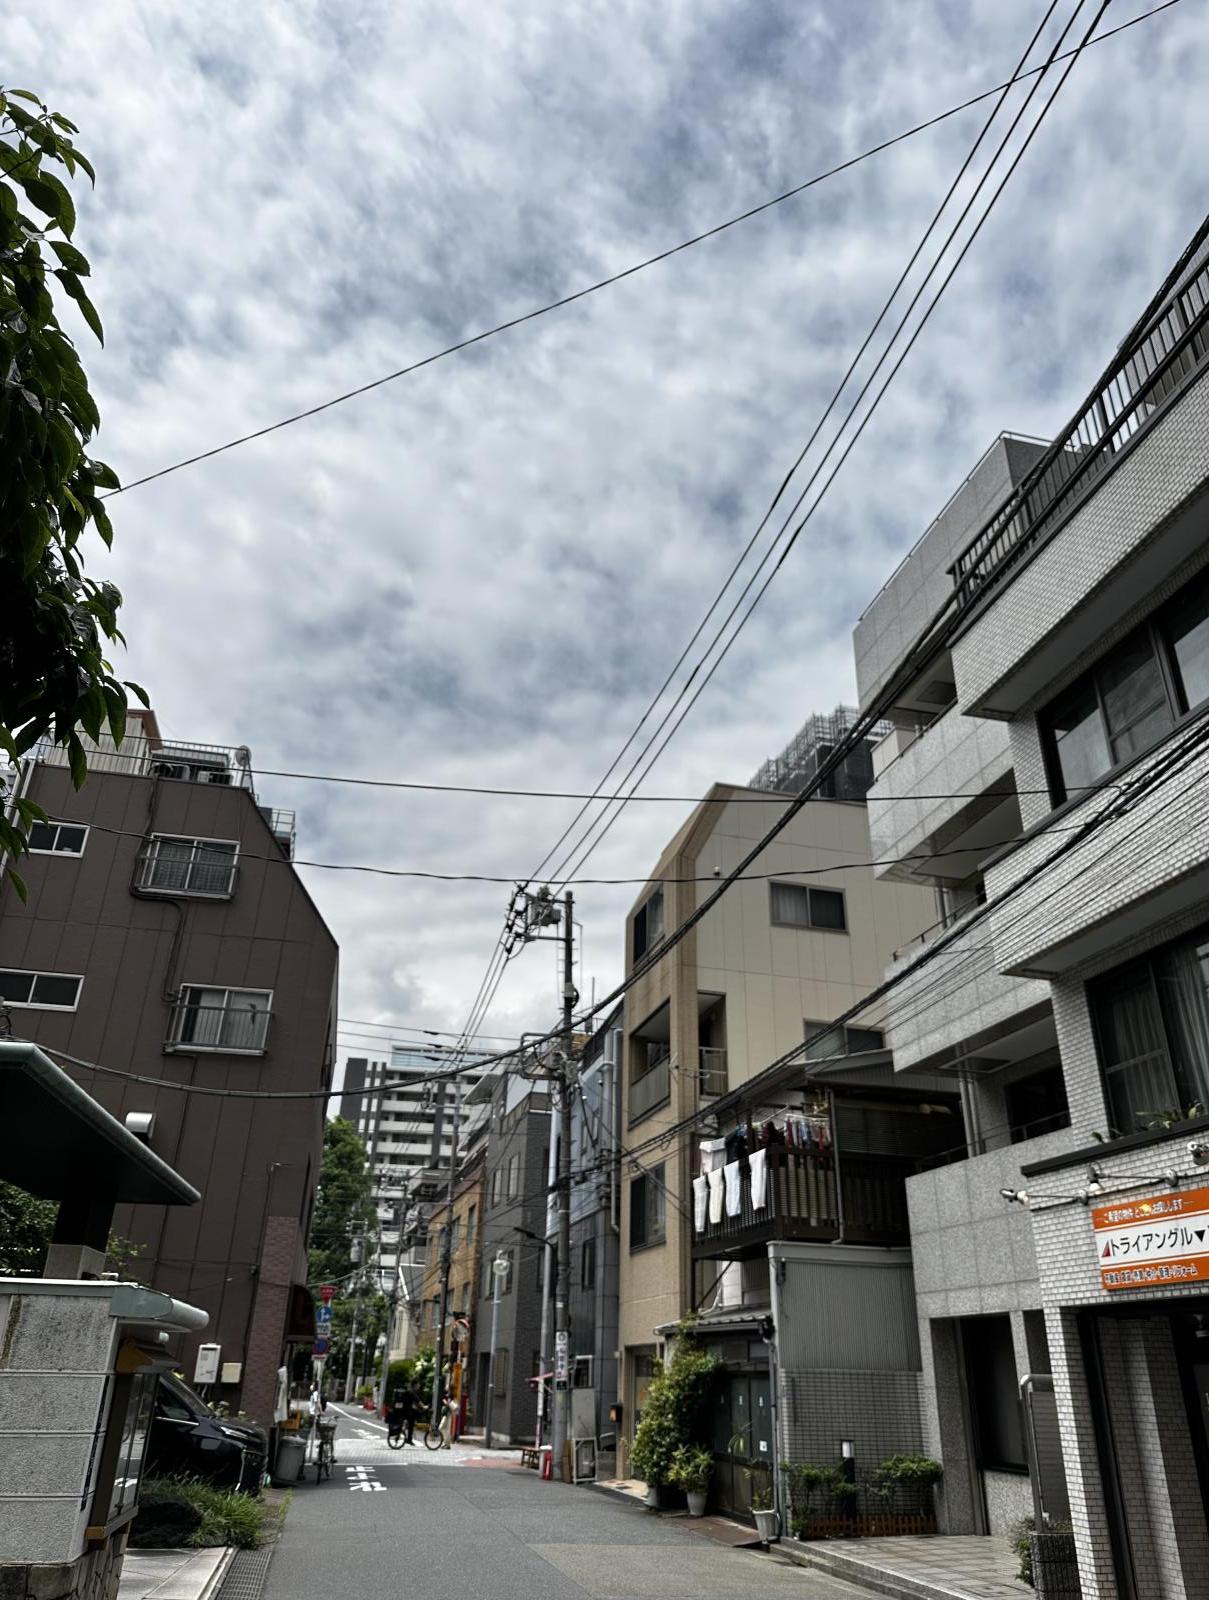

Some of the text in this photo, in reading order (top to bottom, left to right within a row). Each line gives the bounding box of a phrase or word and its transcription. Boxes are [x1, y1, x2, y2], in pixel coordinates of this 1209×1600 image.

[1110, 1227, 1193, 1257] トライアングル
[345, 1466, 387, 1491] 止まれ
